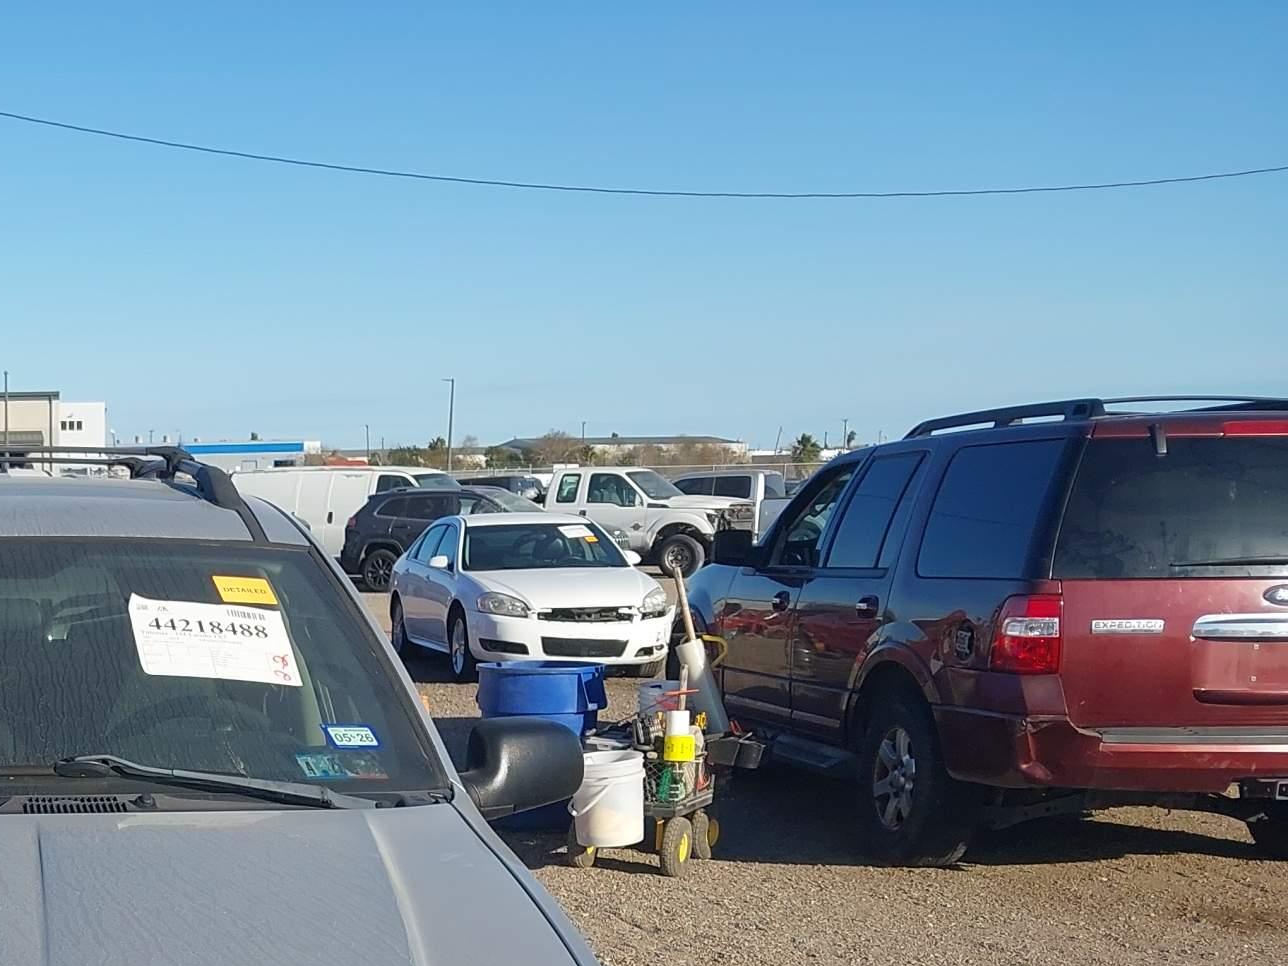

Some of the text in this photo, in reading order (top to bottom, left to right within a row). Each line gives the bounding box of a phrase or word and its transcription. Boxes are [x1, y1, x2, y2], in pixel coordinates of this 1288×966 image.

[222, 586, 268, 595] DETAILED
[148, 617, 269, 639] 44218488
[334, 733, 374, 743] 05 26
